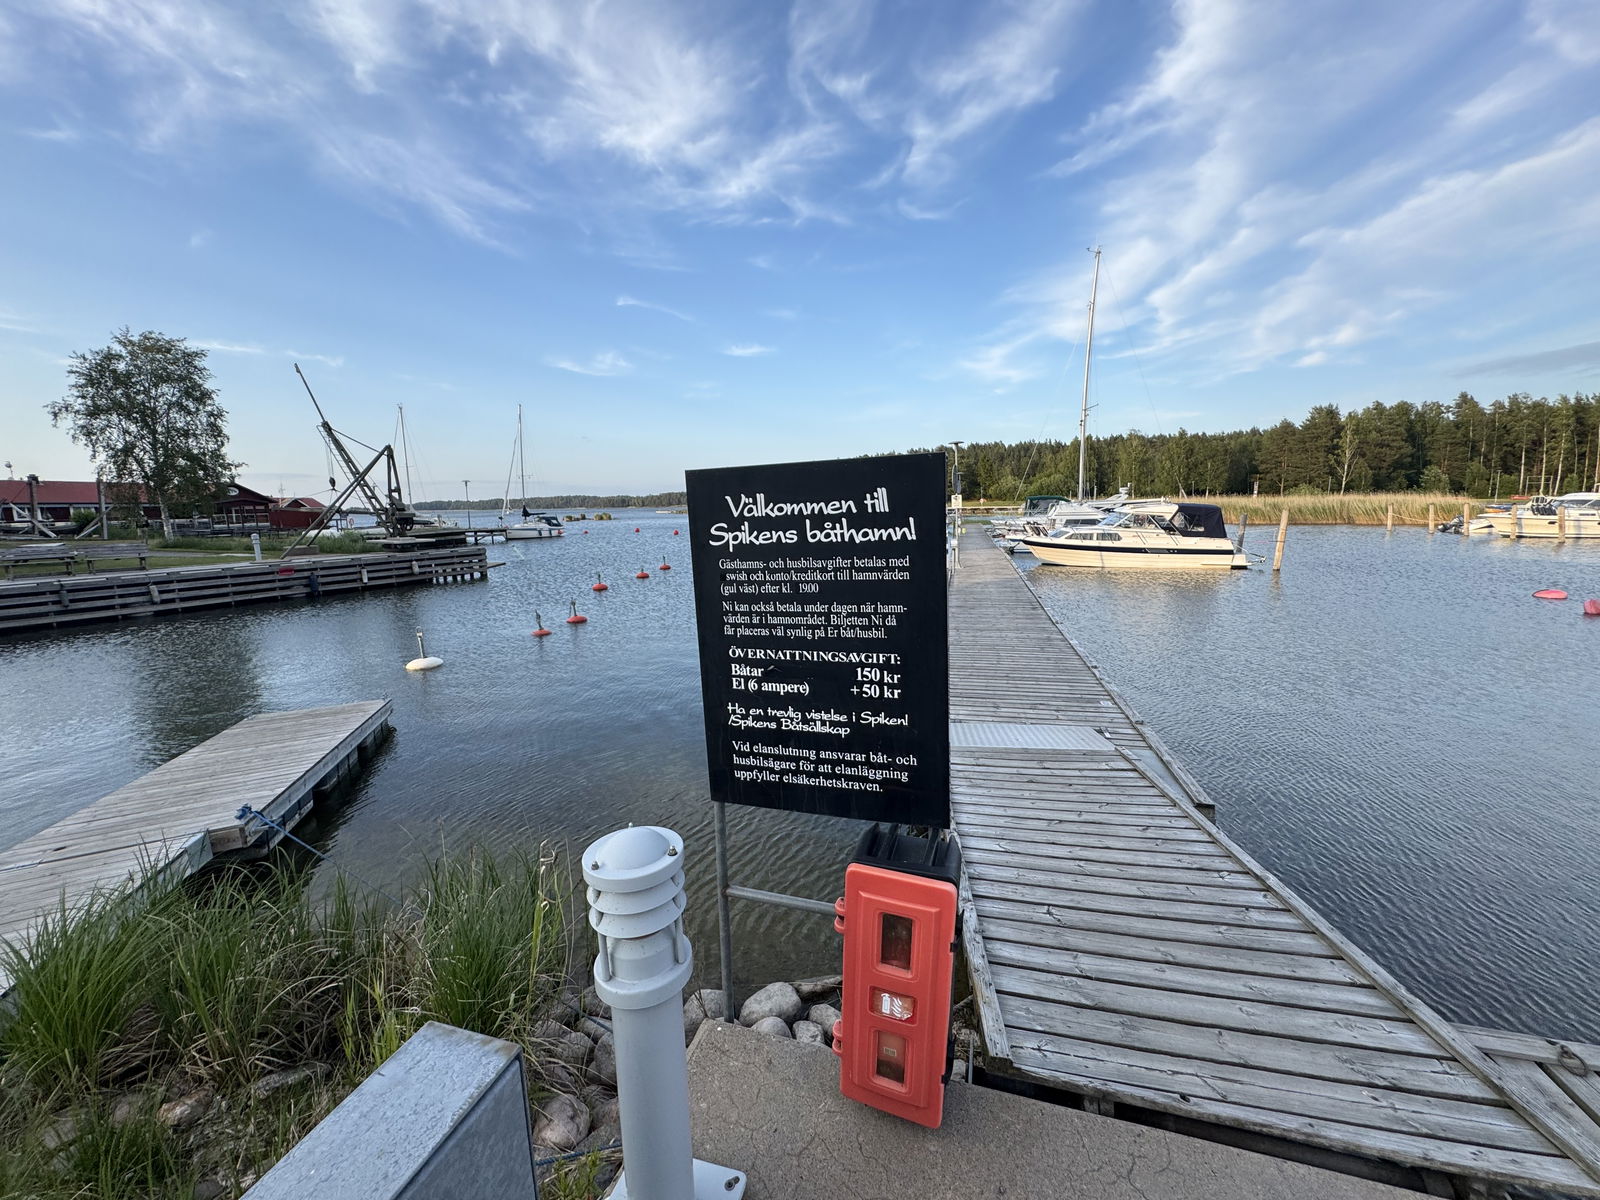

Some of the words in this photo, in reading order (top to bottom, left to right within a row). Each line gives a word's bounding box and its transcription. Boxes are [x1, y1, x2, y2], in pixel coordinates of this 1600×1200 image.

[725, 493, 857, 518] Välkommen
[864, 487, 890, 513] till
[709, 521, 797, 552] Spikens
[806, 517, 917, 543] båthamn!
[719, 559, 767, 568] Gästhamns-
[769, 559, 784, 568] och
[786, 557, 851, 570] husbilsavgifter
[854, 557, 886, 567] betalas
[889, 556, 909, 567] med
[726, 571, 747, 581] swish
[750, 571, 764, 580] och
[766, 570, 834, 581] konto/kreditkort
[837, 570, 849, 580] till
[852, 569, 910, 580] hamnvärden
[720, 584, 736, 595] (gul
[739, 584, 758, 595] väst)
[761, 583, 779, 593] efter
[782, 583, 793, 593] kl.
[722, 601, 732, 611] Ni
[734, 601, 749, 611] kan
[751, 601, 774, 612] också
[776, 602, 801, 612] betala
[804, 602, 829, 612] under
[831, 602, 858, 615] dagen
[860, 603, 875, 612] när
[877, 603, 907, 613] hamn-
[723, 613, 750, 623] värden
[752, 613, 760, 623] är
[762, 613, 765, 624] i
[768, 613, 827, 625] hamnområdet.
[830, 614, 868, 627] Biljetten
[871, 615, 883, 625] Ni
[885, 615, 896, 626] då
[737, 625, 769, 638] placeras
[772, 626, 784, 636] väl
[786, 626, 812, 639] synlig
[815, 627, 825, 640] på
[828, 627, 838, 637] Er
[840, 627, 887, 638] båt/husbil.
[729, 646, 901, 665] ÖVERNATTNINGSAVGIFT:
[731, 664, 764, 677] Båtar
[856, 668, 880, 681] 150
[884, 670, 900, 683] kr
[732, 678, 745, 689] El
[748, 679, 758, 693] (6
[761, 681, 809, 696] ampere)
[884, 685, 901, 699] kr
[727, 703, 745, 714] Ha
[749, 708, 763, 716] en
[767, 706, 801, 722] trevlig
[806, 709, 848, 722] vistelse
[852, 712, 855, 723] i
[728, 714, 776, 730] /Spikens
[781, 718, 850, 738] Båtsällskap
[732, 741, 750, 752] Vid
[753, 743, 816, 759] elanslutning
[819, 750, 865, 761] ansvarar
[870, 751, 892, 763] båt-
[896, 754, 917, 766] och
[733, 754, 796, 769] husbilsägare
[799, 759, 815, 771] för
[818, 764, 832, 773] att
[835, 764, 908, 782] elanläggning
[734, 769, 780, 782] uppfyller
[783, 773, 883, 792] elsäkerhetskraven.
